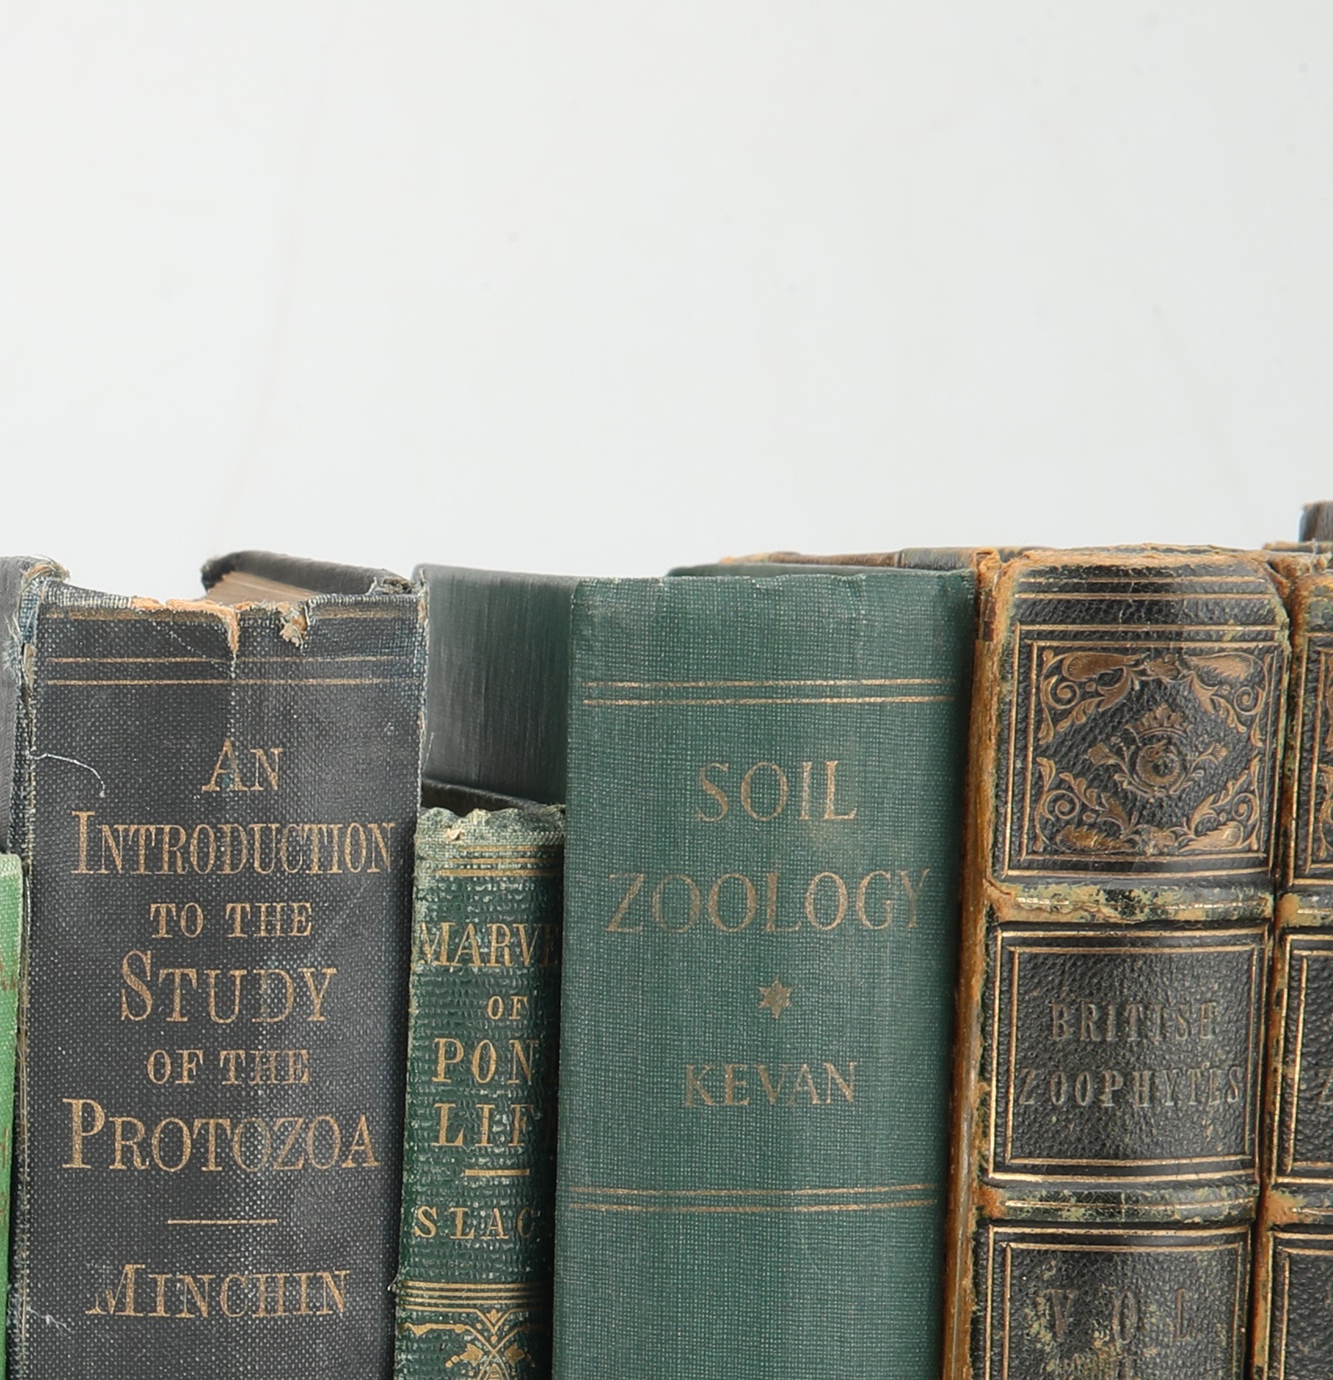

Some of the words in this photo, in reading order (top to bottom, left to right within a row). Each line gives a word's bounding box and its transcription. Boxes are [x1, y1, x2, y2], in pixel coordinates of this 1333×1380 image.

[202, 737, 284, 792] AN
[696, 761, 857, 822] SOIL
[70, 811, 395, 876] INTRODUCTION
[149, 902, 204, 938] TO
[225, 902, 313, 938] THE
[604, 869, 930, 933] ZOOLOGY
[120, 950, 337, 1025] STUDY
[487, 995, 527, 1020] OF
[1050, 1002, 1217, 1043] BRITISH
[146, 1049, 203, 1085] OF
[219, 1049, 311, 1085] THE
[431, 1037, 555, 1084] PON
[685, 1061, 858, 1107] KEVAN
[1018, 1065, 1242, 1107] ZOOPHYTES
[62, 1098, 380, 1172] PROTOZOA
[431, 1103, 554, 1146] LIF
[413, 1206, 551, 1239] SLAC
[85, 1264, 349, 1319] MINCHIN
